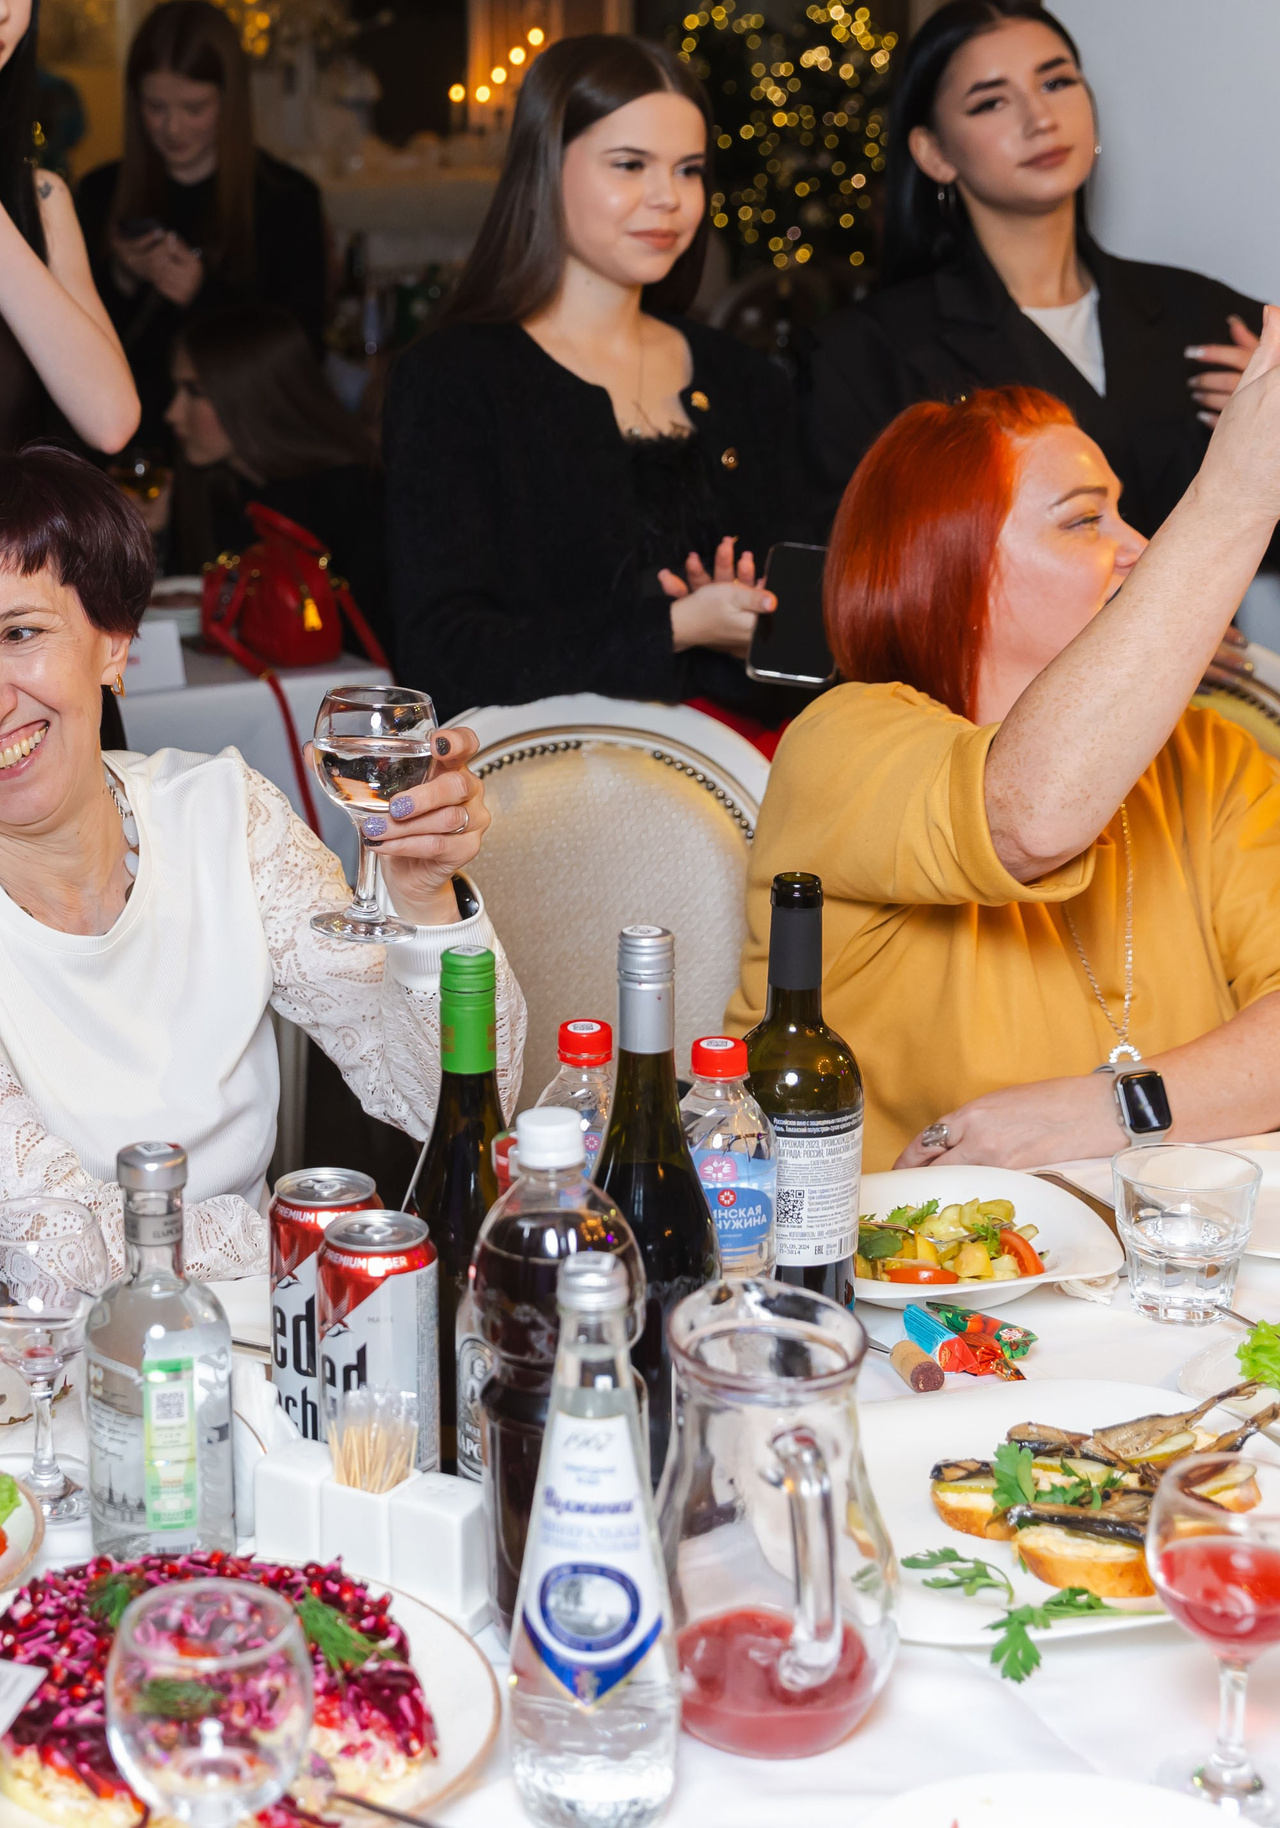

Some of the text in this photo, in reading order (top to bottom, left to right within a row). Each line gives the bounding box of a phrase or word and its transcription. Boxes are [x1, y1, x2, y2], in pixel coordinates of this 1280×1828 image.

[781, 1138, 805, 1149] УРОЖАЯ
[805, 1139, 820, 1149] 2023,
[275, 1204, 316, 1224] PREMIUM
[324, 1249, 368, 1269] PREMIUM
